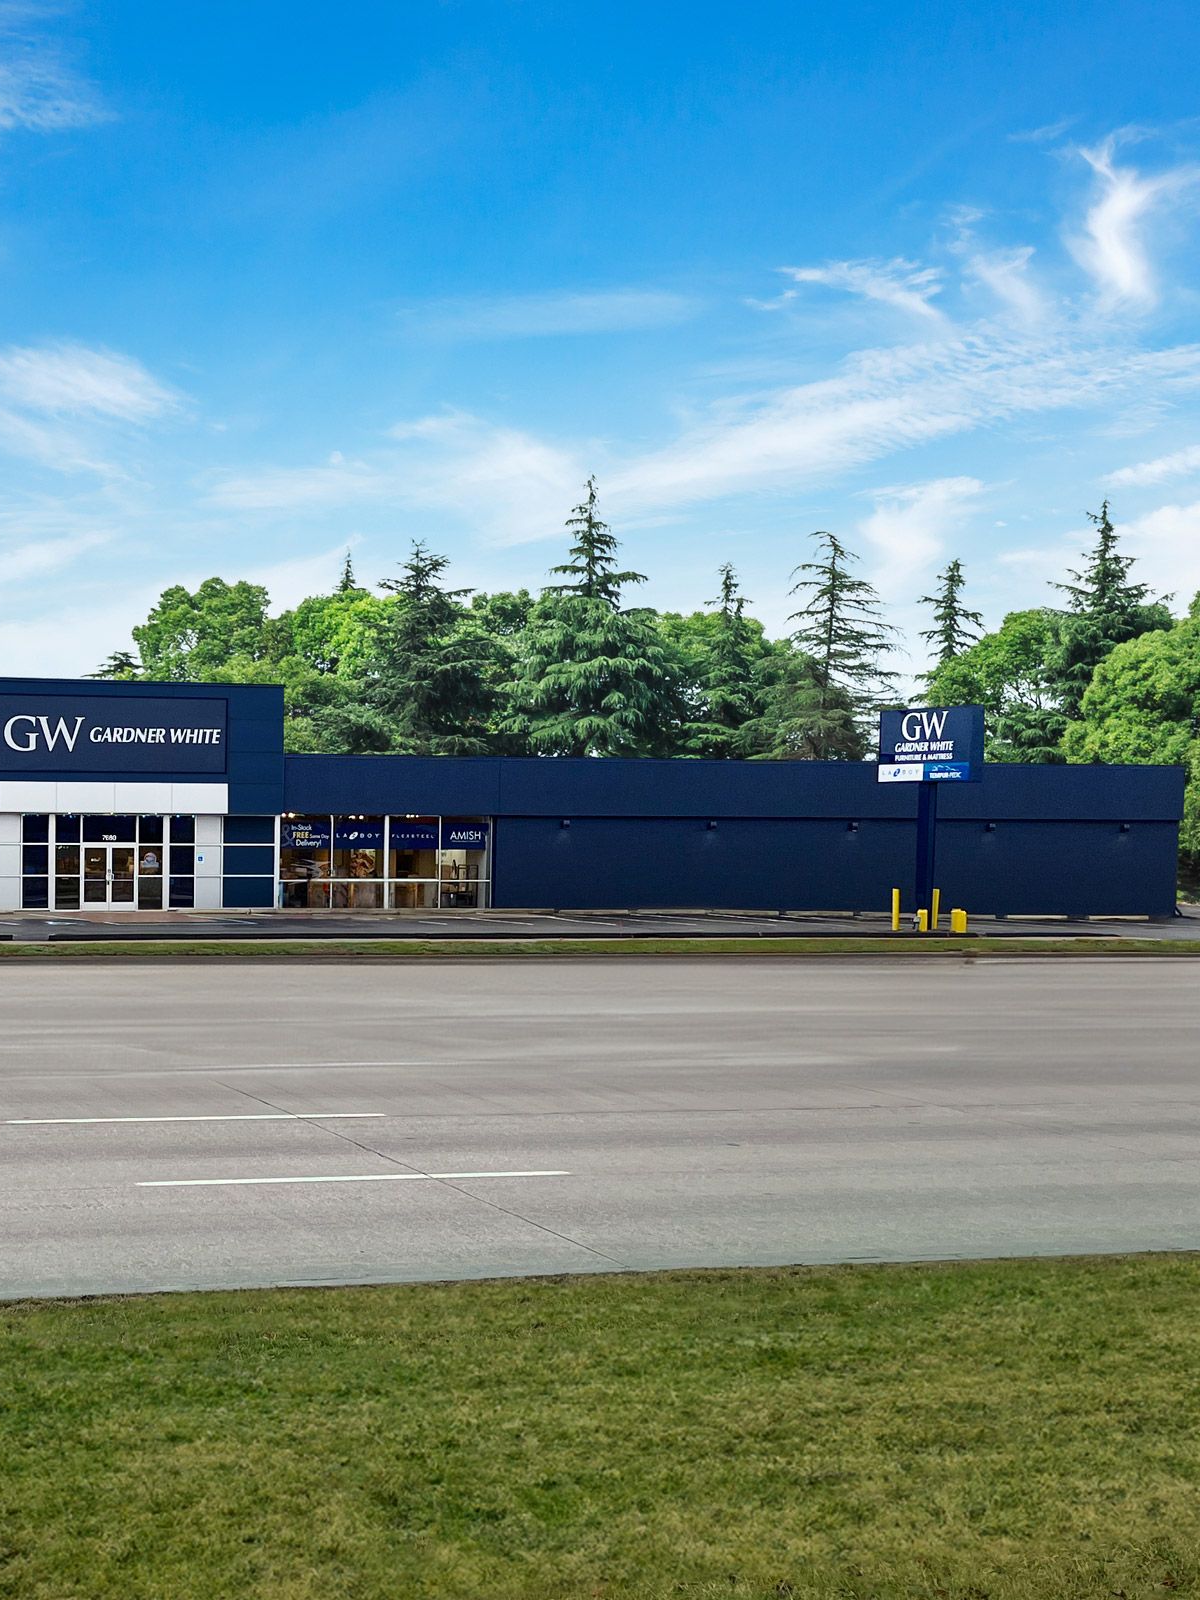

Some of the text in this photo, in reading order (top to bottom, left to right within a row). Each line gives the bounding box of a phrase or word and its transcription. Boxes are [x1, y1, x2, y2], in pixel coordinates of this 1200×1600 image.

[901, 710, 949, 741] GW
[3, 714, 222, 752] GW GARDNER WHITE
[894, 740, 954, 753] GARDNER WHITE
[927, 752, 953, 760] MATTRESS
[292, 831, 309, 839] FREE
[449, 831, 481, 840] AMISH
[295, 839, 322, 848] Delivery!
